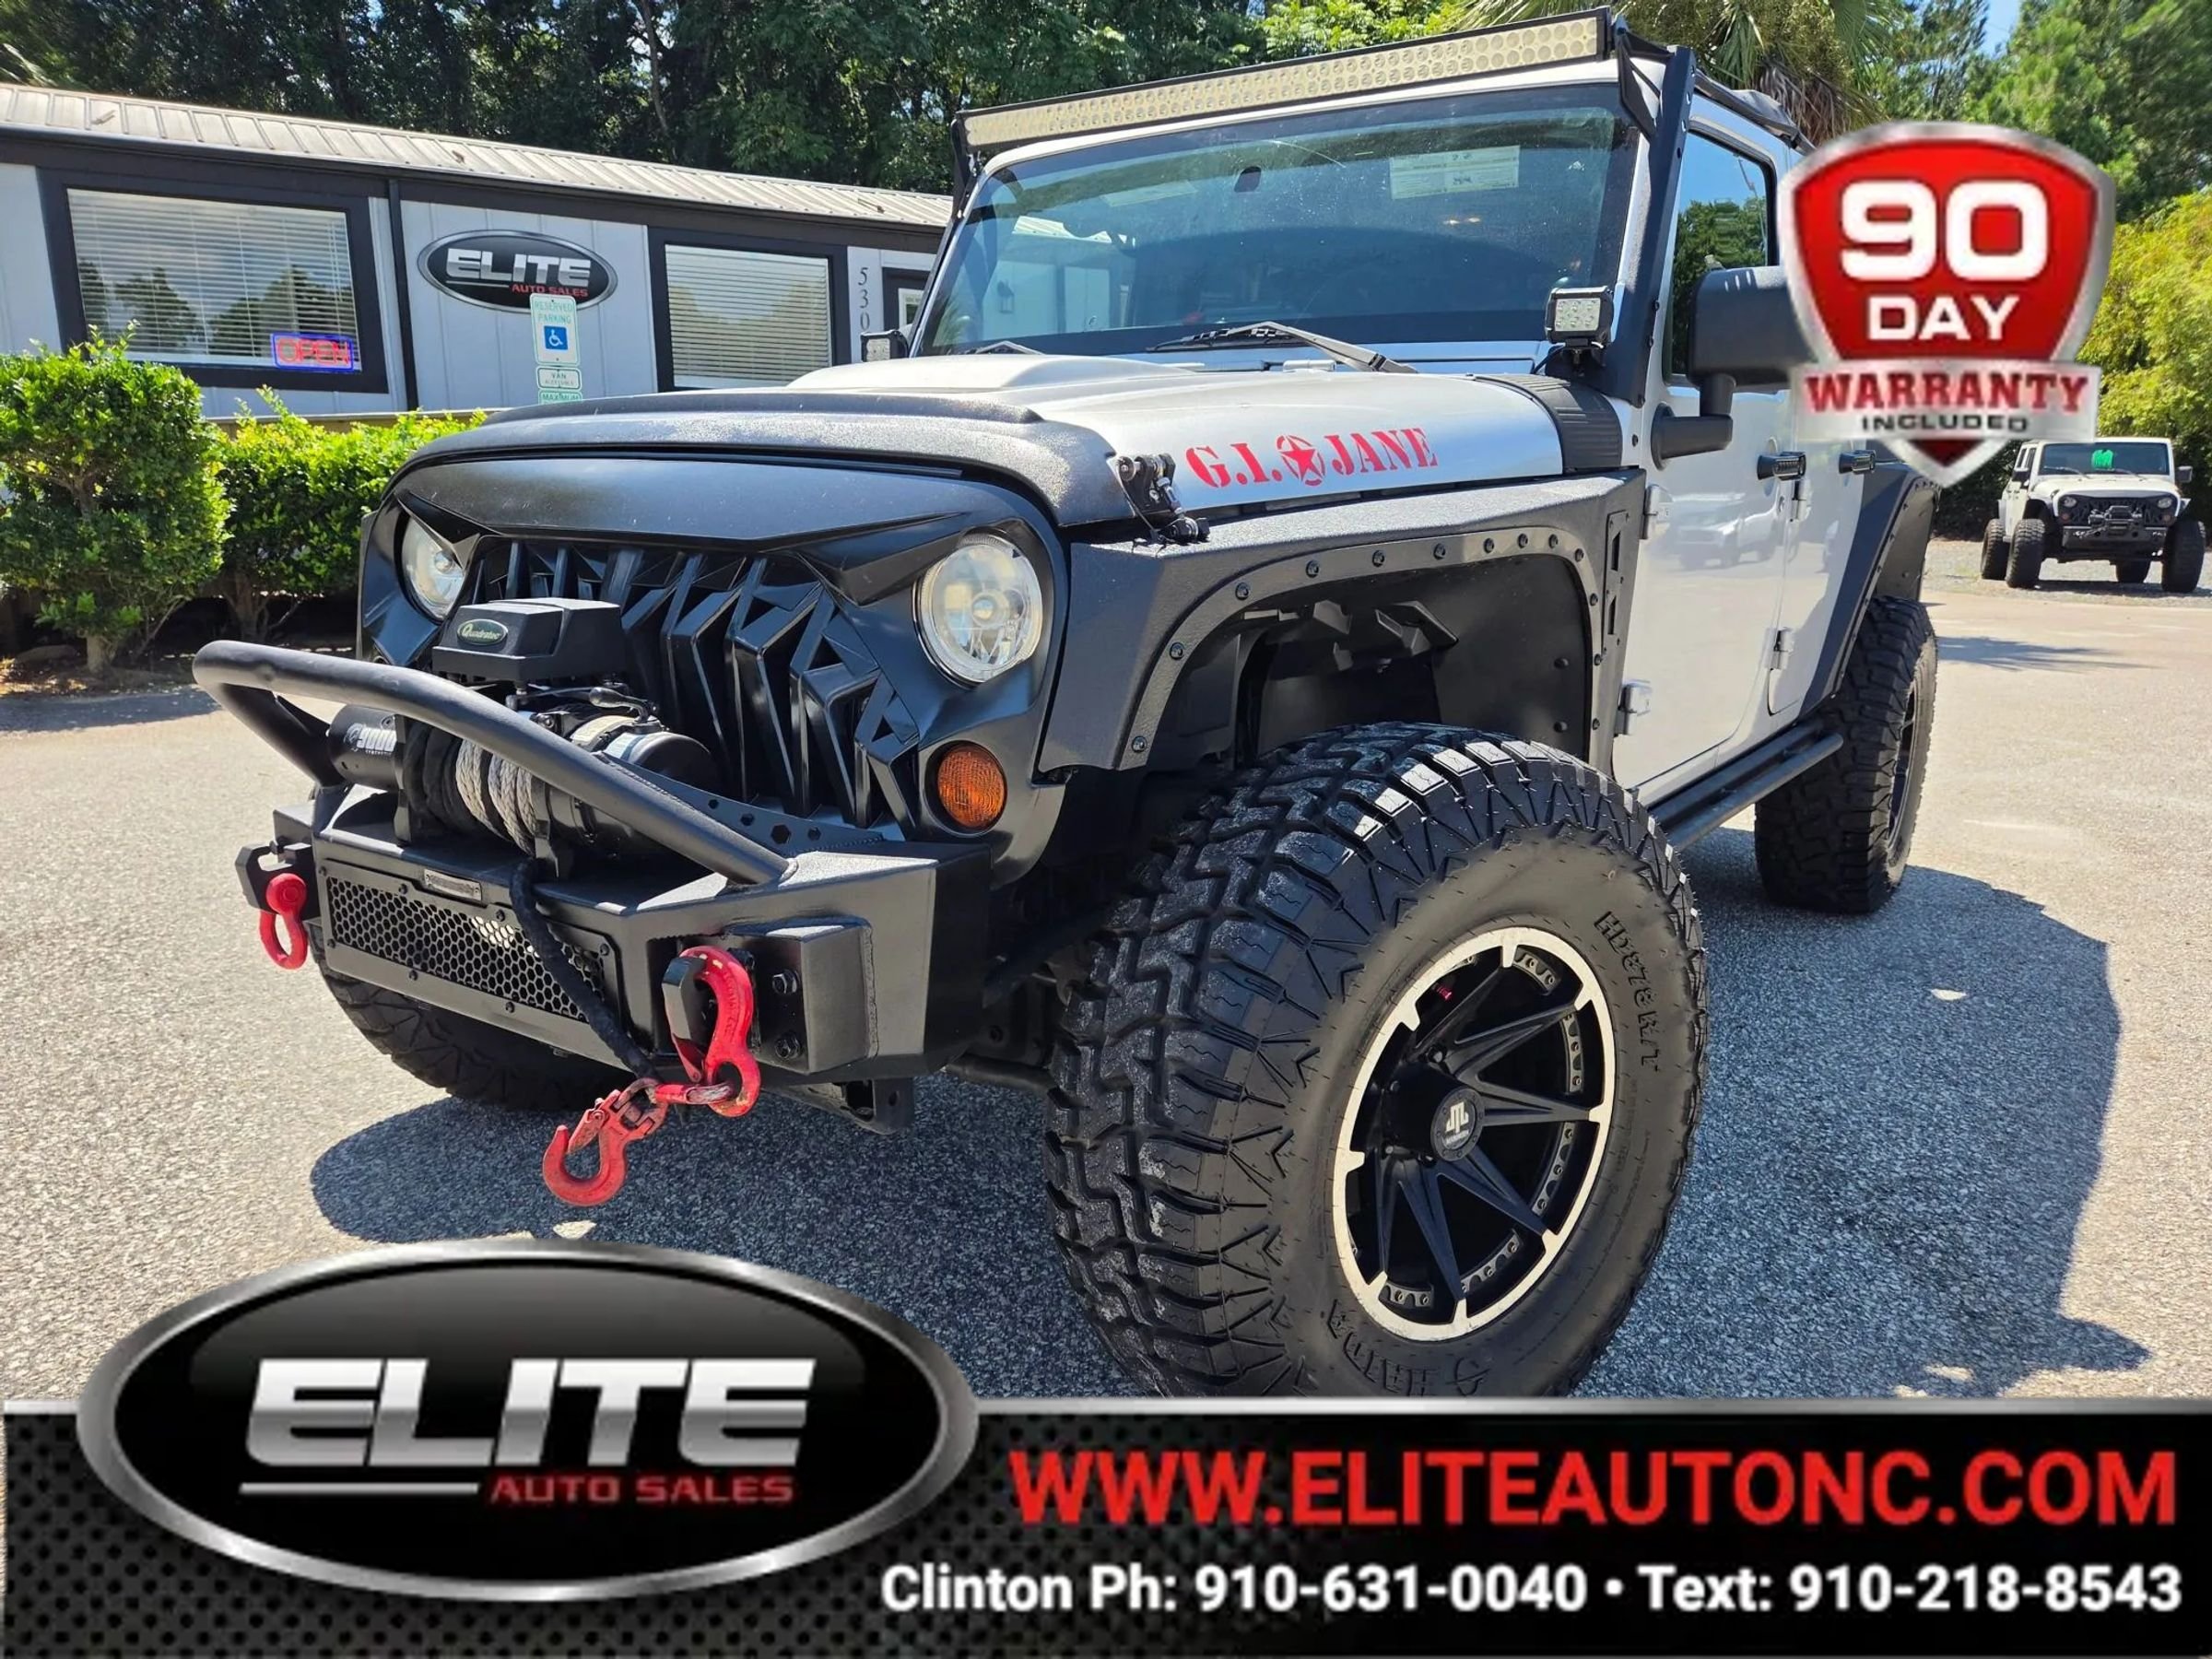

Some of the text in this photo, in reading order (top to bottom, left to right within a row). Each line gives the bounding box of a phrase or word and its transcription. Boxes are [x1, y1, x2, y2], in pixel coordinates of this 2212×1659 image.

[446, 248, 591, 288] ELITE
[511, 283, 589, 298] AUTO SALES
[535, 300, 574, 312] RESERVED
[537, 313, 571, 324] PARKING
[276, 336, 349, 366] OPEN
[1185, 427, 1439, 488] G.I. JANE
